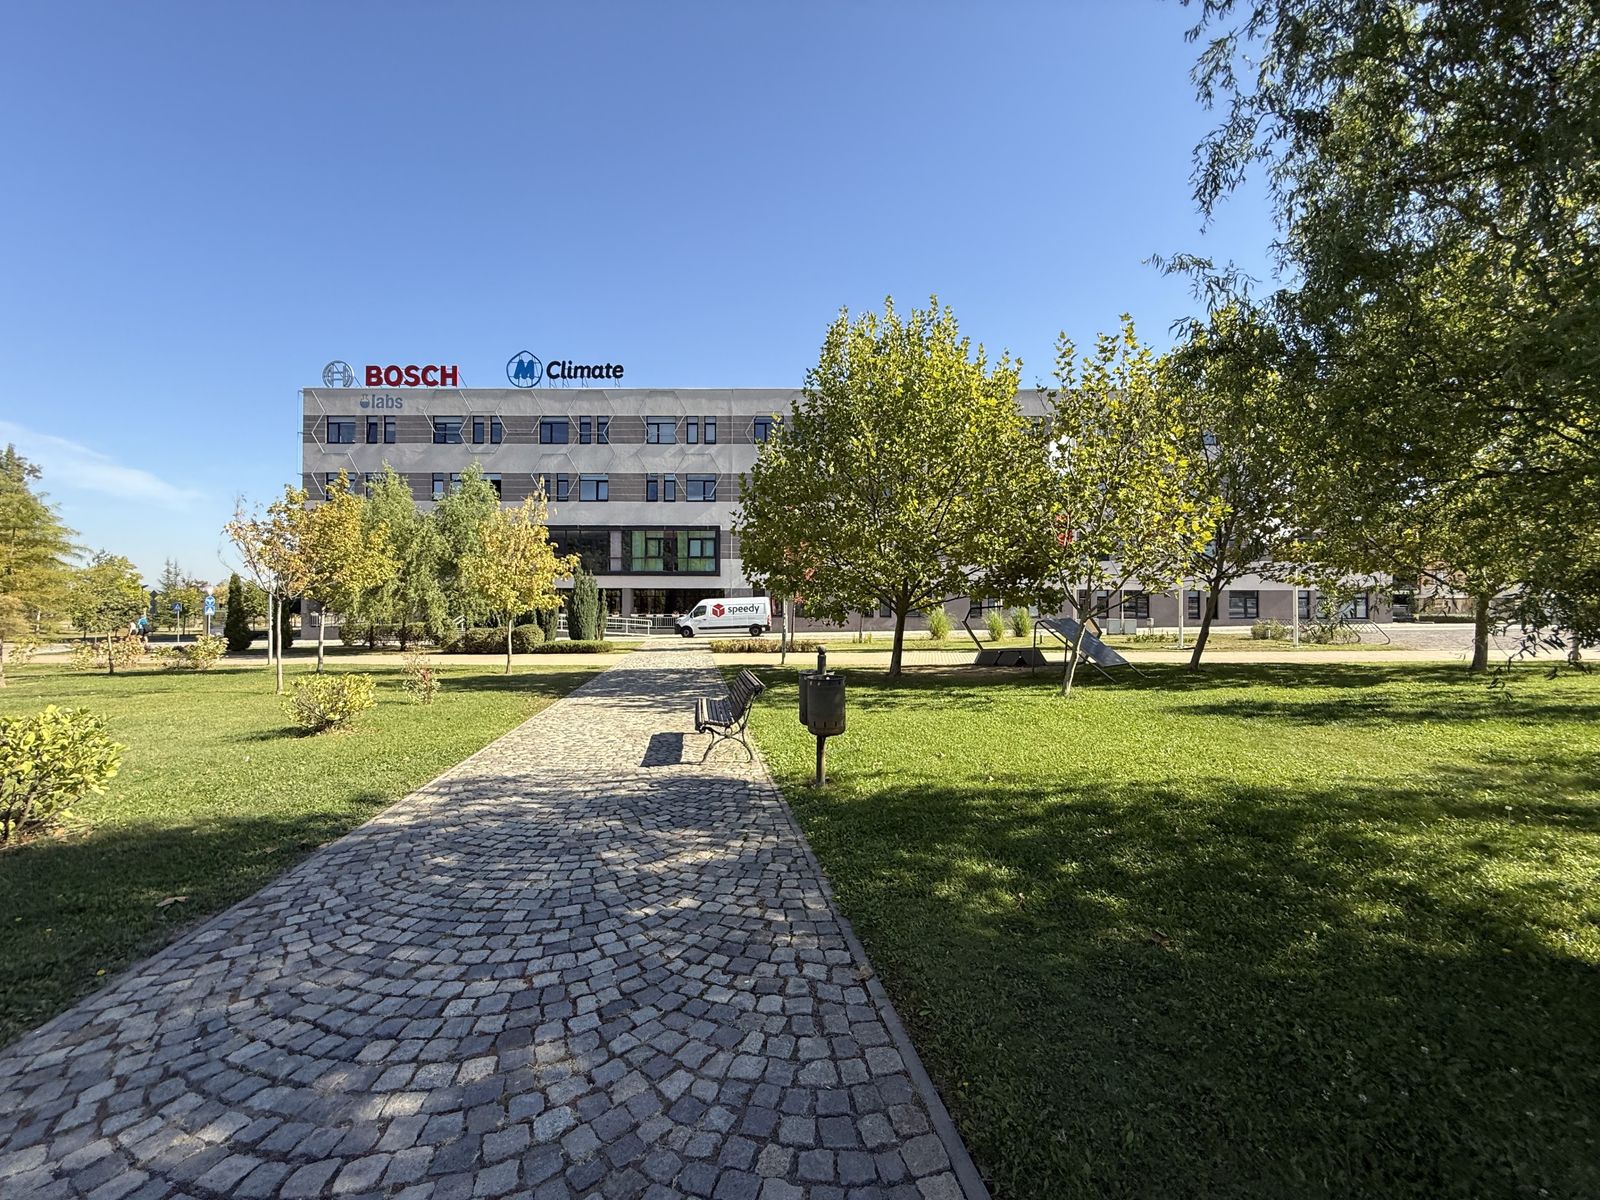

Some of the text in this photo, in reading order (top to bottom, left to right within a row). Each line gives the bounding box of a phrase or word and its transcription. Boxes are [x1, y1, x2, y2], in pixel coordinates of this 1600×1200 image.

[365, 365, 458, 387] BOSCH
[546, 360, 624, 379] Climate
[370, 394, 403, 409] labs
[728, 604, 760, 614] speedy
